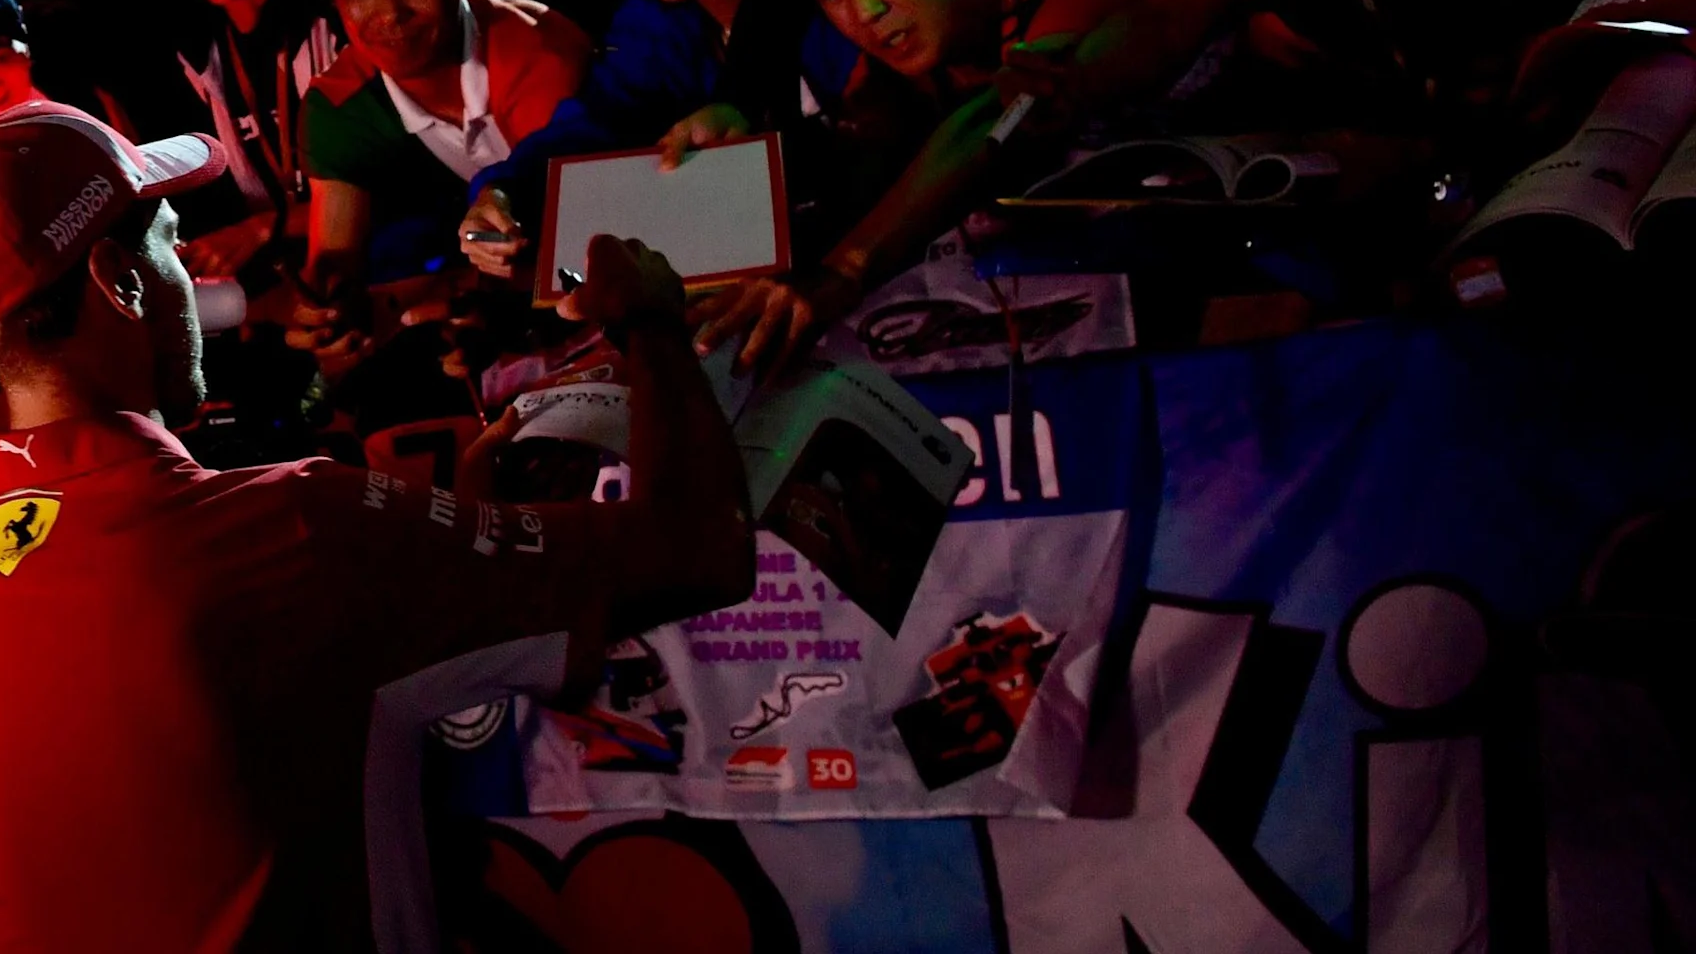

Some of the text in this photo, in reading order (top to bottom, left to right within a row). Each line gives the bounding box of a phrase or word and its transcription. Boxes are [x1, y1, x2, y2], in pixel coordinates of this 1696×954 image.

[42, 174, 108, 240] MISSION
[682, 611, 822, 634] JAPANESE
[692, 640, 861, 662] GRAND PRIX
[810, 757, 853, 782] 30
